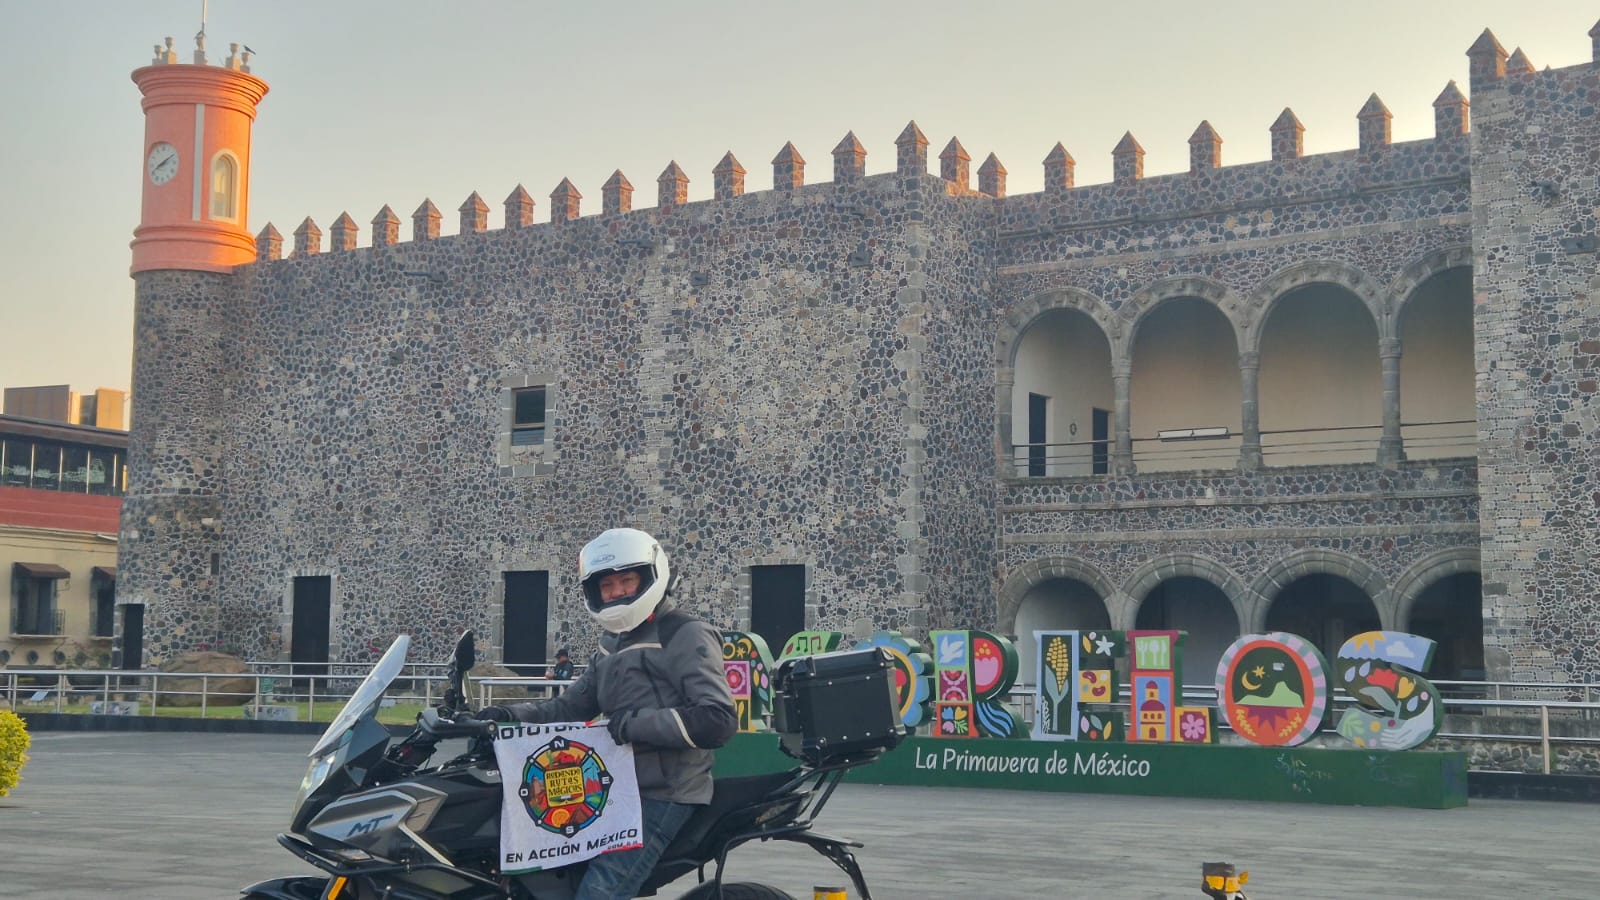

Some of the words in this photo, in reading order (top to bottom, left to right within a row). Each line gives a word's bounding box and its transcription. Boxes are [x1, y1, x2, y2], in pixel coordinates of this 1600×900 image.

[554, 740, 564, 748] N
[915, 747, 937, 770] La
[943, 748, 1039, 772] Primavera
[1045, 749, 1067, 775] de
[1073, 751, 1150, 776] México
[346, 814, 394, 837] MT
[505, 852, 523, 863] EN
[528, 842, 580, 861] ACCIÓN
[586, 828, 638, 852] MÉXICO
